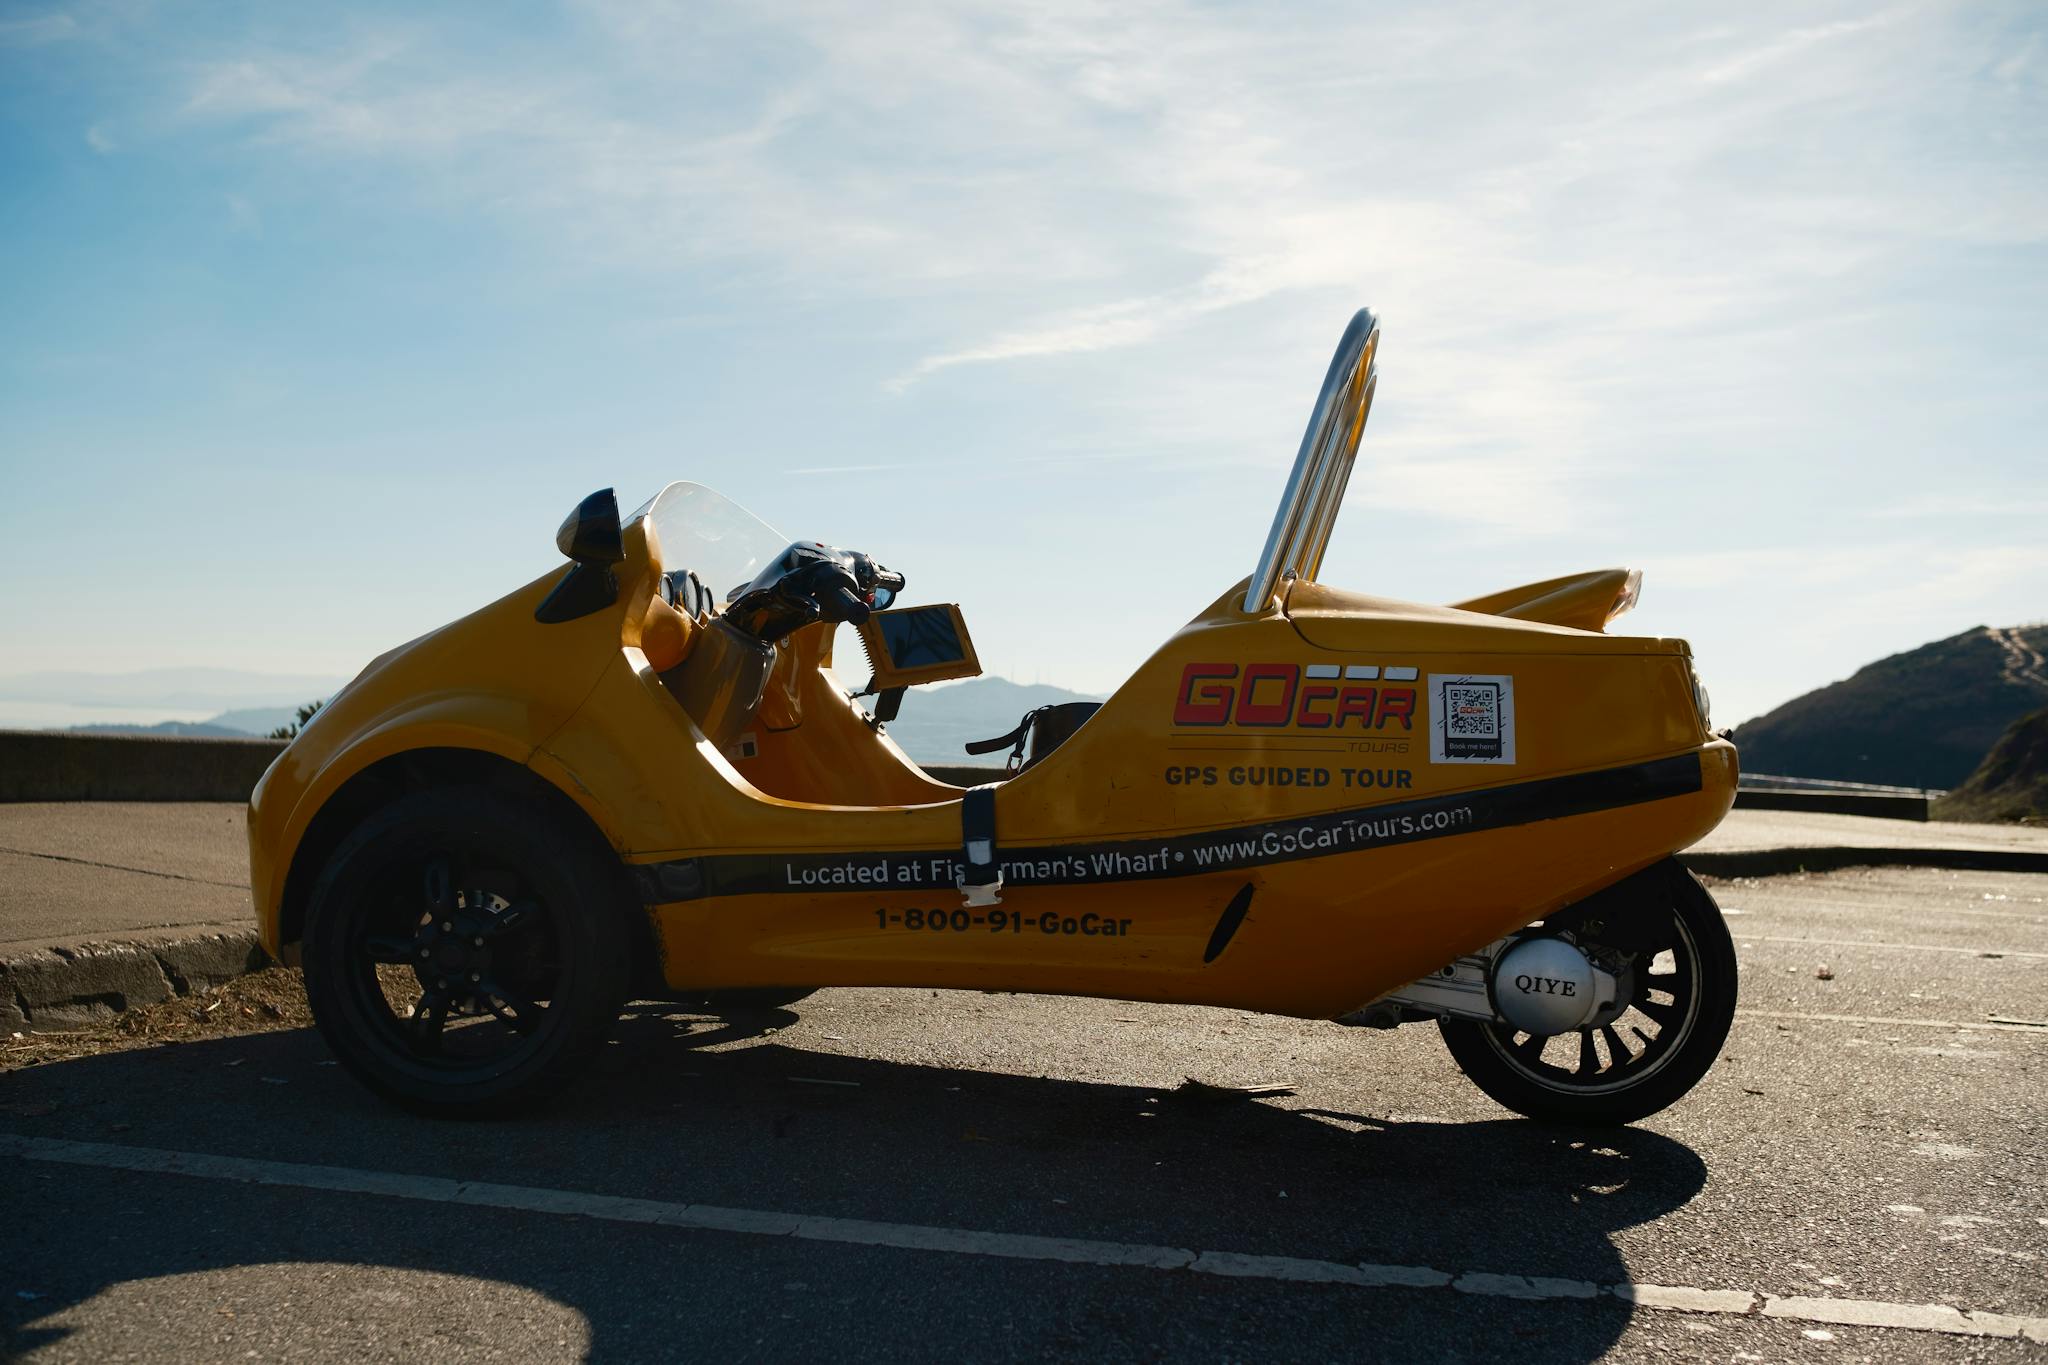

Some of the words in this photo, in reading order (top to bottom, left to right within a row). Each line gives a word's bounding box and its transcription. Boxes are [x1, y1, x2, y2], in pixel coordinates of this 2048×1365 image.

[1346, 742, 1410, 754] TOURS
[1449, 742, 1466, 751] Book
[1479, 742, 1497, 751] here!
[1165, 766, 1218, 786] GPS
[1228, 767, 1331, 788] GUIDED
[1341, 768, 1413, 789] TOUR
[786, 860, 889, 886] Located
[897, 861, 922, 883] at
[931, 855, 1087, 883] Fisrman's
[1091, 847, 1169, 875] Wharf
[1193, 805, 1473, 866] www.GoCarTours.com
[875, 907, 1133, 936] 1-800-91-GoCar
[1515, 975, 1576, 996] QIYE
